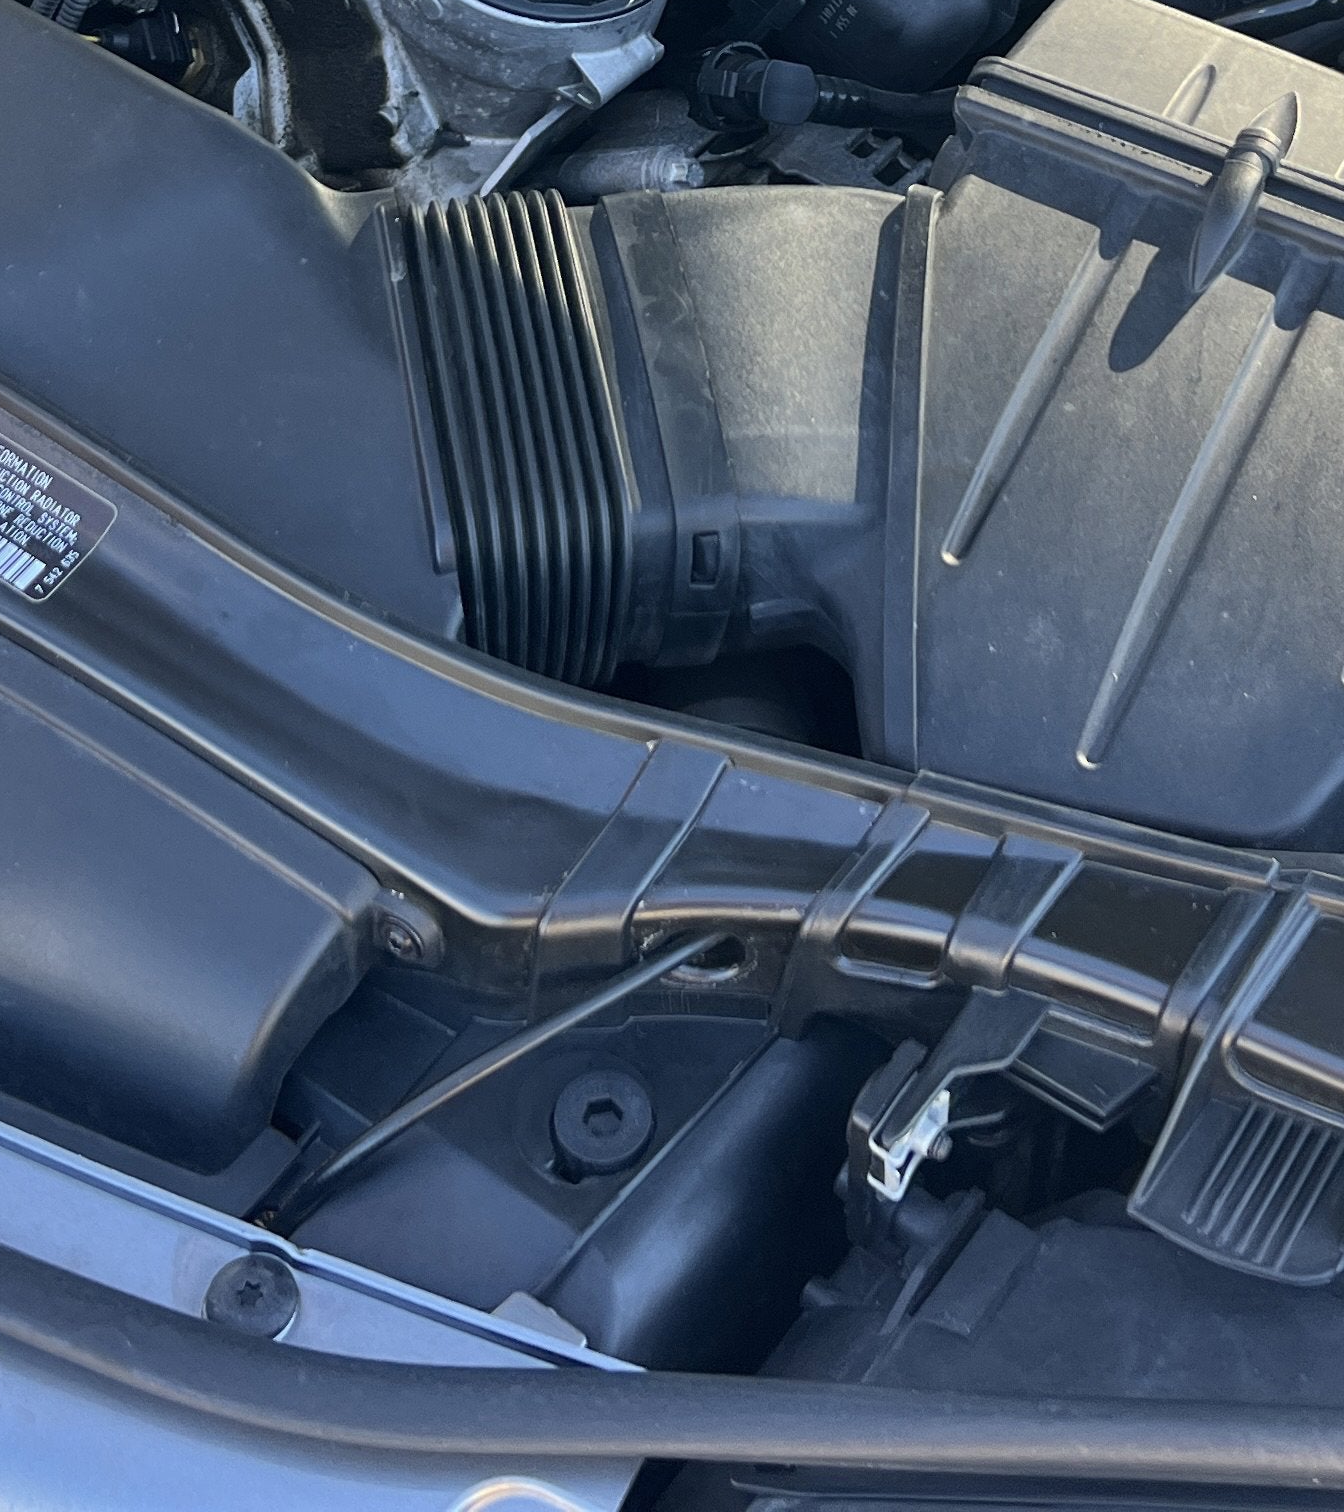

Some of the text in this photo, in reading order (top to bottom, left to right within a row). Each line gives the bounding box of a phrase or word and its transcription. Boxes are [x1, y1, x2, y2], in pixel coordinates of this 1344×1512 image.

[29, 489, 81, 527] RADIATOR
[13, 513, 69, 553] REDUCTION
[34, 584, 44, 594] 7
